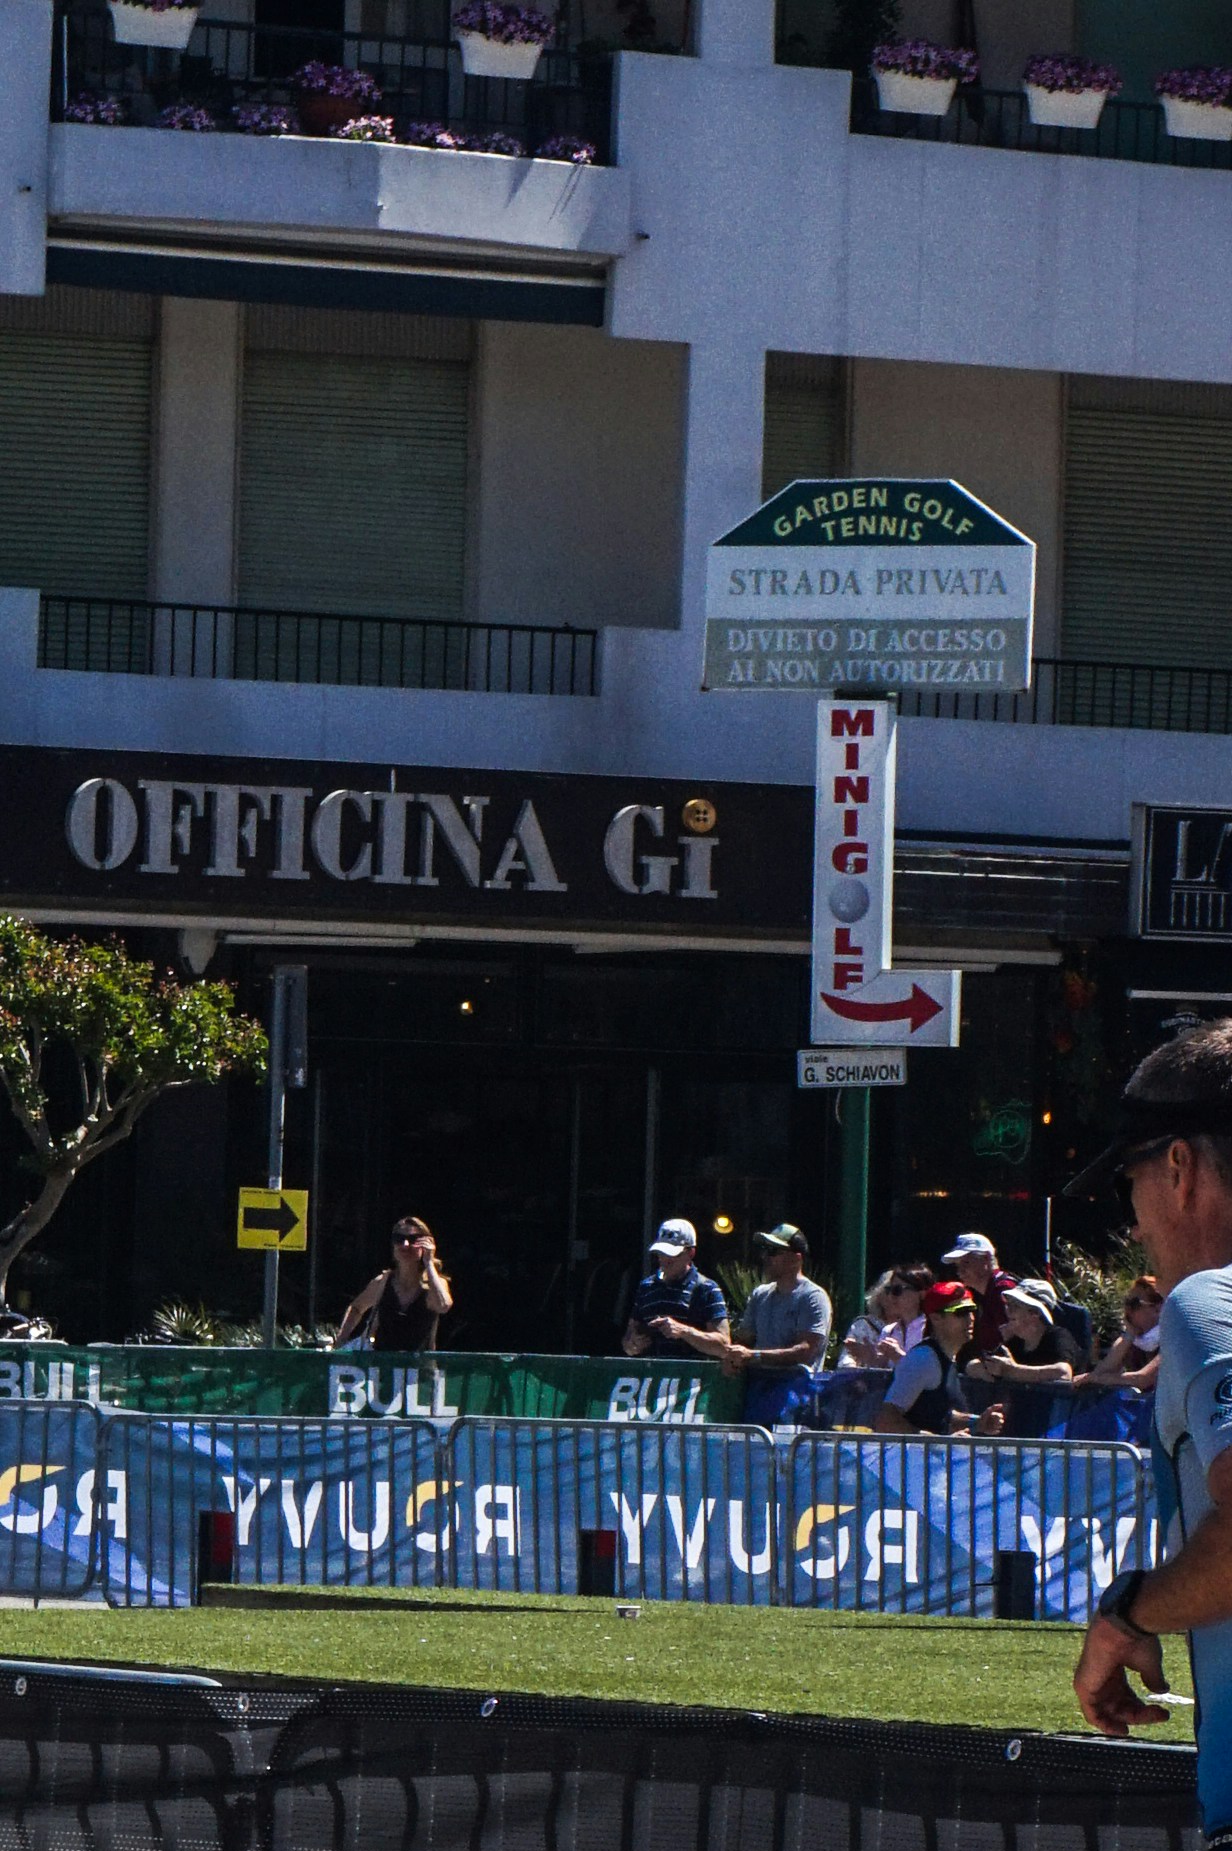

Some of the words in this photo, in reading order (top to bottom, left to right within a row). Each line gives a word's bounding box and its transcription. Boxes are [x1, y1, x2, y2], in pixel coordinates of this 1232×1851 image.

[774, 487, 887, 538] GARDEN
[904, 492, 975, 537] GOLF
[821, 515, 925, 543] TENNIS
[729, 569, 862, 597] STRADA
[876, 568, 1008, 597] PRIVATA
[727, 628, 838, 652] DIVIETO
[850, 629, 878, 652] DI
[884, 628, 1006, 652] ACCESSO
[727, 659, 757, 683] AI
[765, 659, 820, 683] NON
[829, 659, 1005, 683] AUTORIZZATI
[66, 770, 568, 892] OFFICINA
[804, 1067, 819, 1083] G.
[826, 1064, 900, 1082] SCHIAVON
[328, 1365, 458, 1418] BULL
[608, 1377, 705, 1424] BULL
